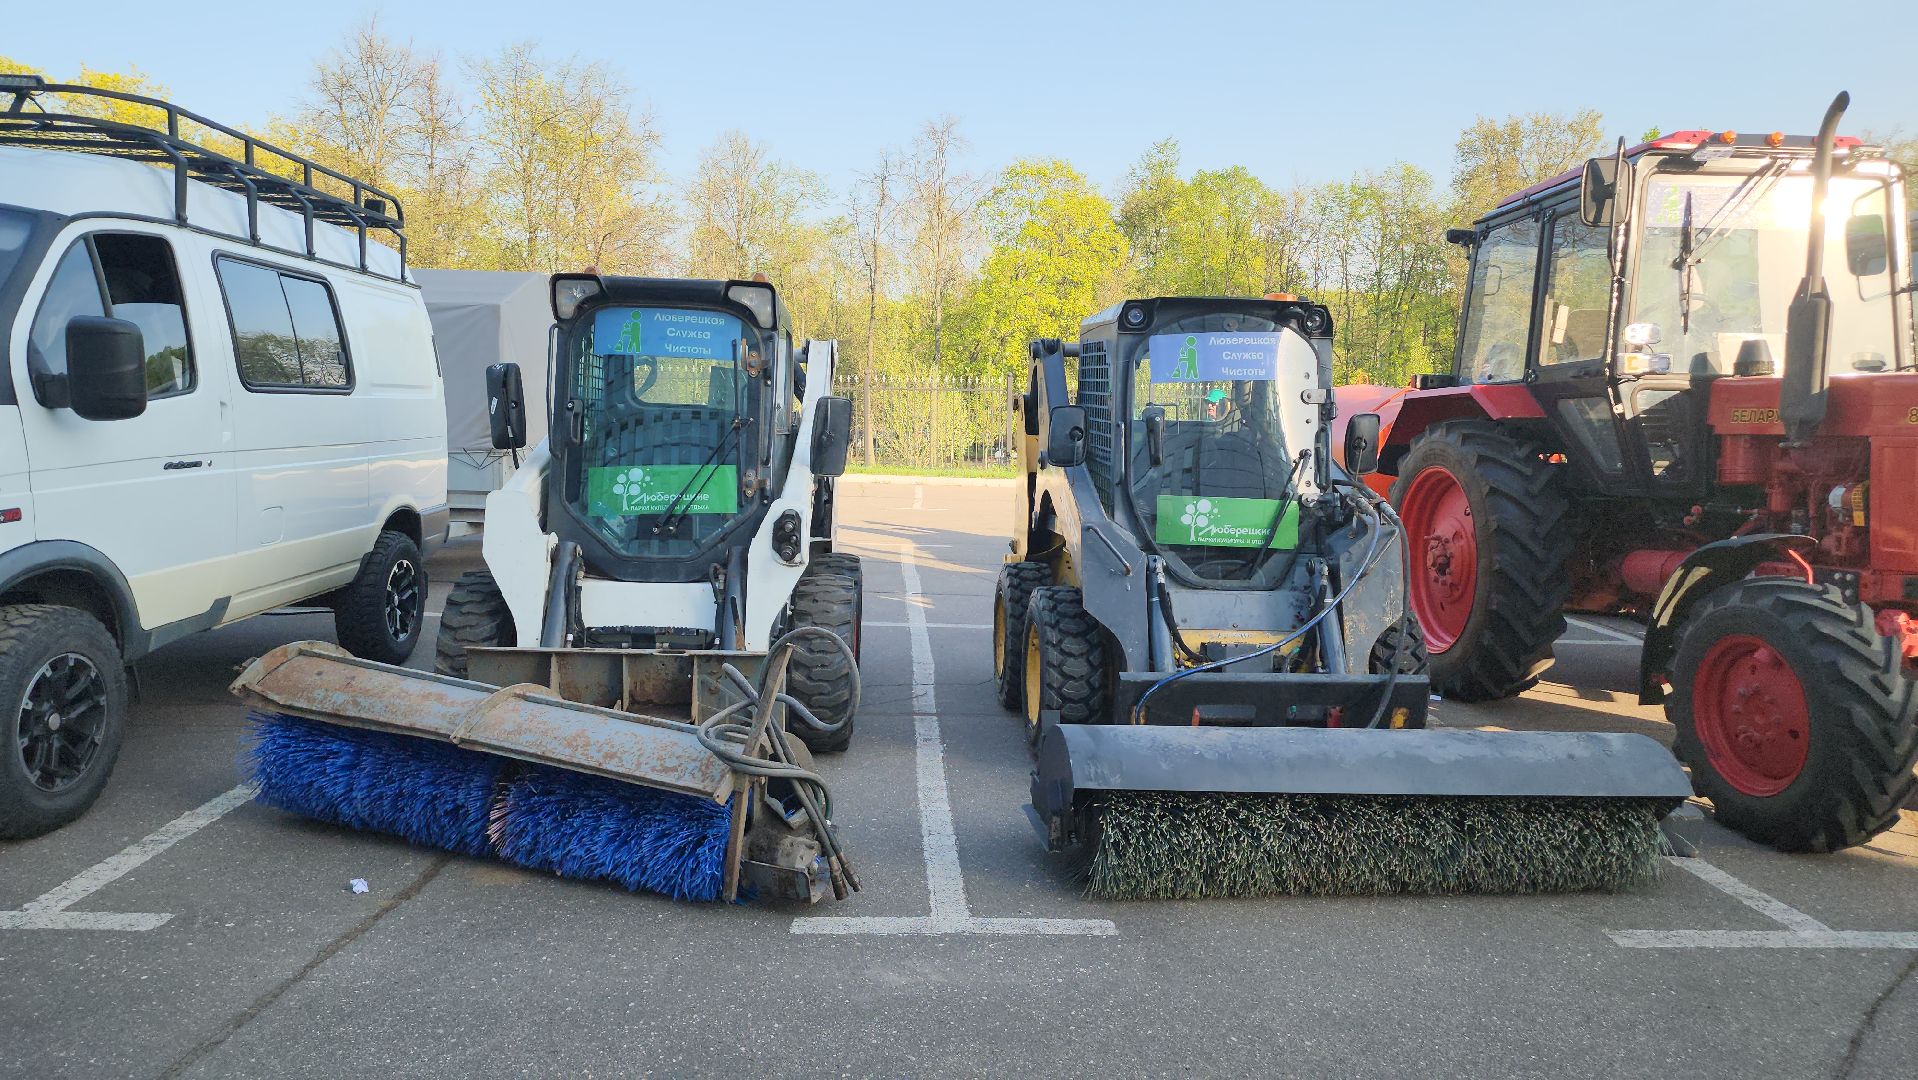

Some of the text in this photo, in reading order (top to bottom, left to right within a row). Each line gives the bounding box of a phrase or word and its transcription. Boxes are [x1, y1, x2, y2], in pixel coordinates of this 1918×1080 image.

[666, 327, 711, 339] Служба
[664, 343, 712, 355] Чистоты
[1222, 351, 1264, 360] Служба
[1221, 367, 1266, 376] Чистоты
[1730, 408, 1781, 423] БЕЛАРУ
